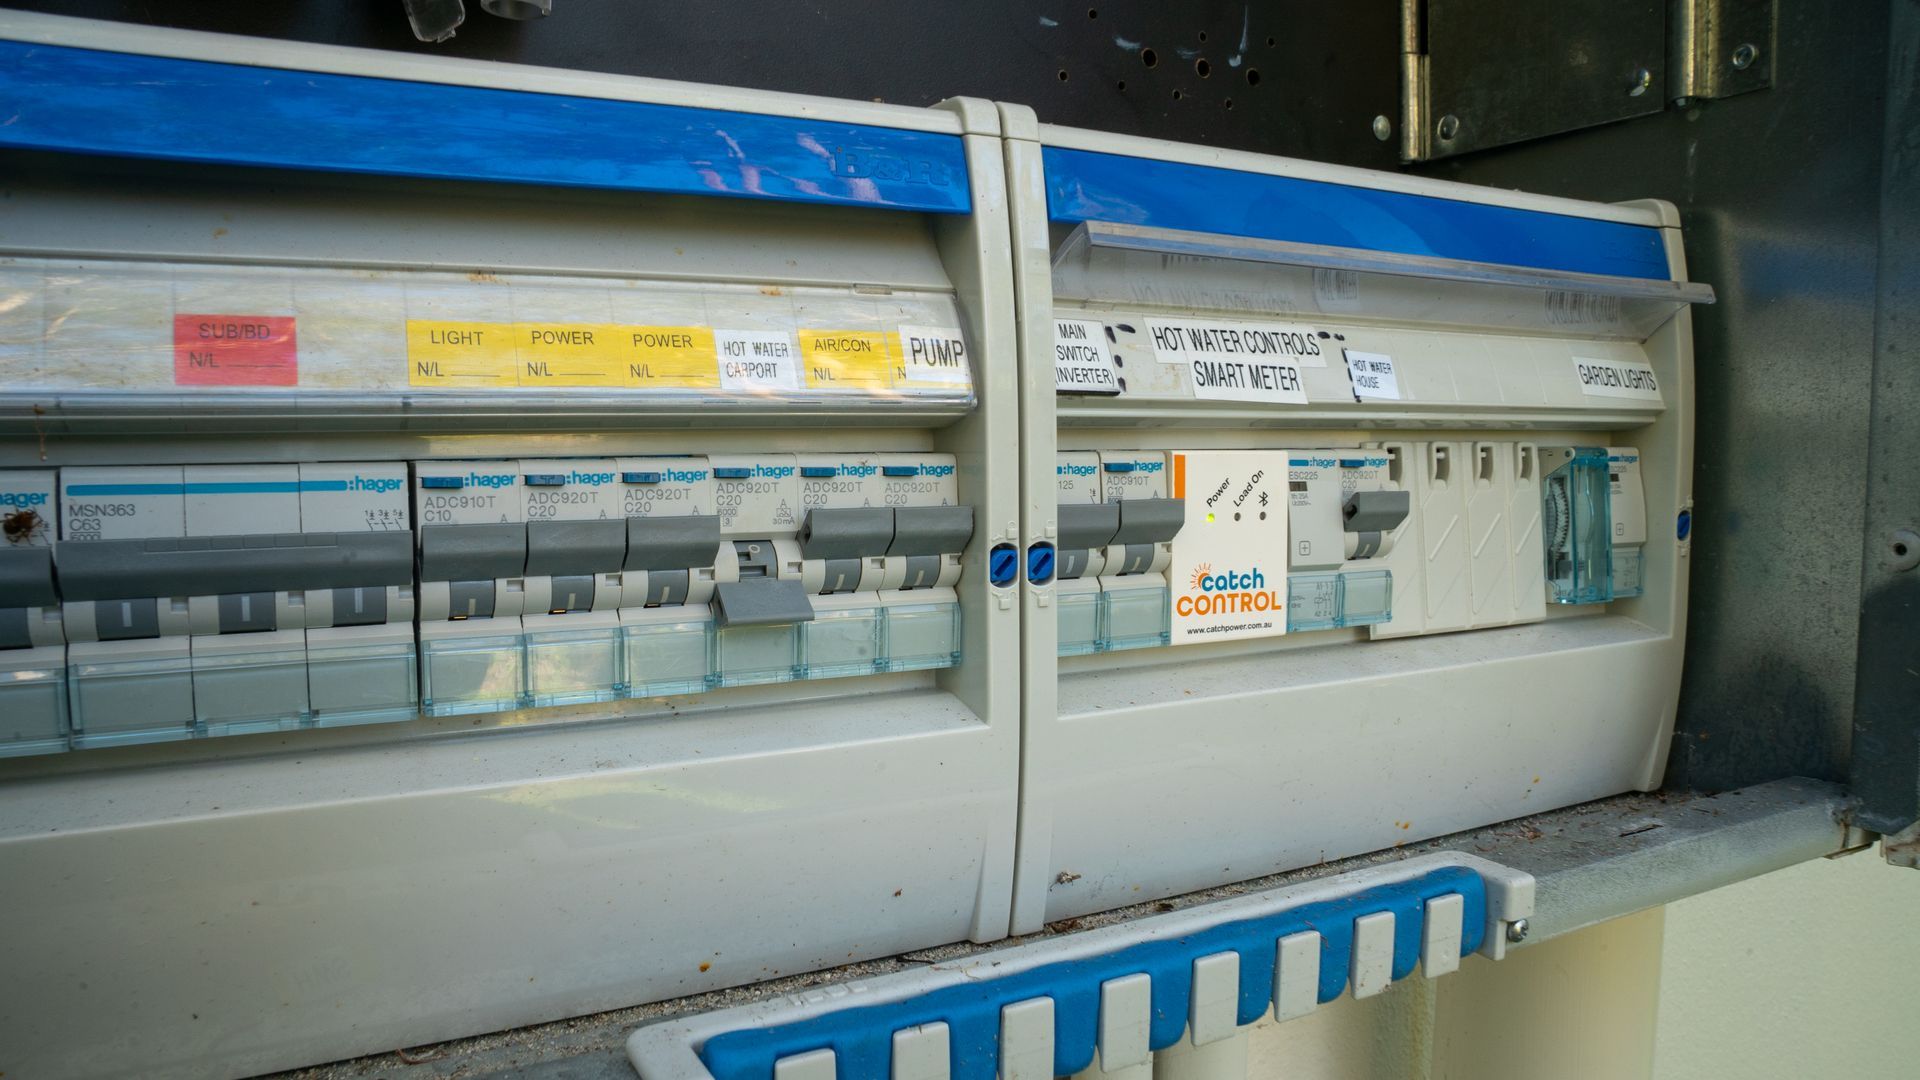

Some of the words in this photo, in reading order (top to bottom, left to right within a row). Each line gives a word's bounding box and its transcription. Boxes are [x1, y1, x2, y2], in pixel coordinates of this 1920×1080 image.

[199, 323, 271, 340] SUB/BD
[431, 330, 484, 346] LIGHT
[531, 330, 595, 345] POWER
[1058, 323, 1087, 340] MAIN
[633, 333, 693, 348] POWER
[814, 338, 872, 353] AIR/CON
[1153, 326, 1185, 352] HOT
[1187, 328, 1242, 354] WATER
[1243, 330, 1321, 357] CONTROLS
[723, 340, 746, 357] HOT
[752, 341, 789, 358] WATER
[909, 336, 965, 368] PUMP
[1056, 344, 1100, 362] SWITCH
[189, 352, 220, 368] N/L
[1352, 359, 1367, 372] HOT
[1369, 361, 1392, 374] WATER
[417, 361, 445, 377] N/L
[527, 361, 553, 377] N/L
[630, 363, 655, 378] N/L
[726, 362, 778, 379] CARPORT
[813, 367, 836, 381] N/L
[1195, 359, 1246, 389] SMART
[1248, 363, 1301, 393] METER
[1356, 375, 1380, 389] HOUSE
[1577, 363, 1621, 388] GARDEN
[1620, 367, 1657, 392] LIGHTS
[1106, 475, 1150, 486] ADC910T
[1288, 471, 1319, 480] ESC225
[624, 488, 691, 501] ADC920T
[716, 482, 780, 494] ADC920T
[803, 481, 863, 493] ADC920T
[885, 481, 941, 493] ADC920T
[1107, 486, 1124, 496] C10
[1206, 477, 1231, 508] Power
[1233, 481, 1254, 507] Load
[1251, 469, 1264, 484] On
[424, 495, 497, 510] ADC910T
[527, 491, 599, 504] ADC920T
[716, 494, 742, 506] C20
[803, 493, 828, 505] C20
[884, 494, 908, 505] C20
[69, 503, 136, 518] MSN363
[527, 504, 557, 518] C20
[624, 501, 652, 514] C20
[424, 509, 452, 522] C10
[69, 518, 101, 532] C63
[1201, 567, 1265, 592] catch
[1176, 591, 1282, 617] CONTROL
[1187, 621, 1273, 635] www.catchpower.com.au
